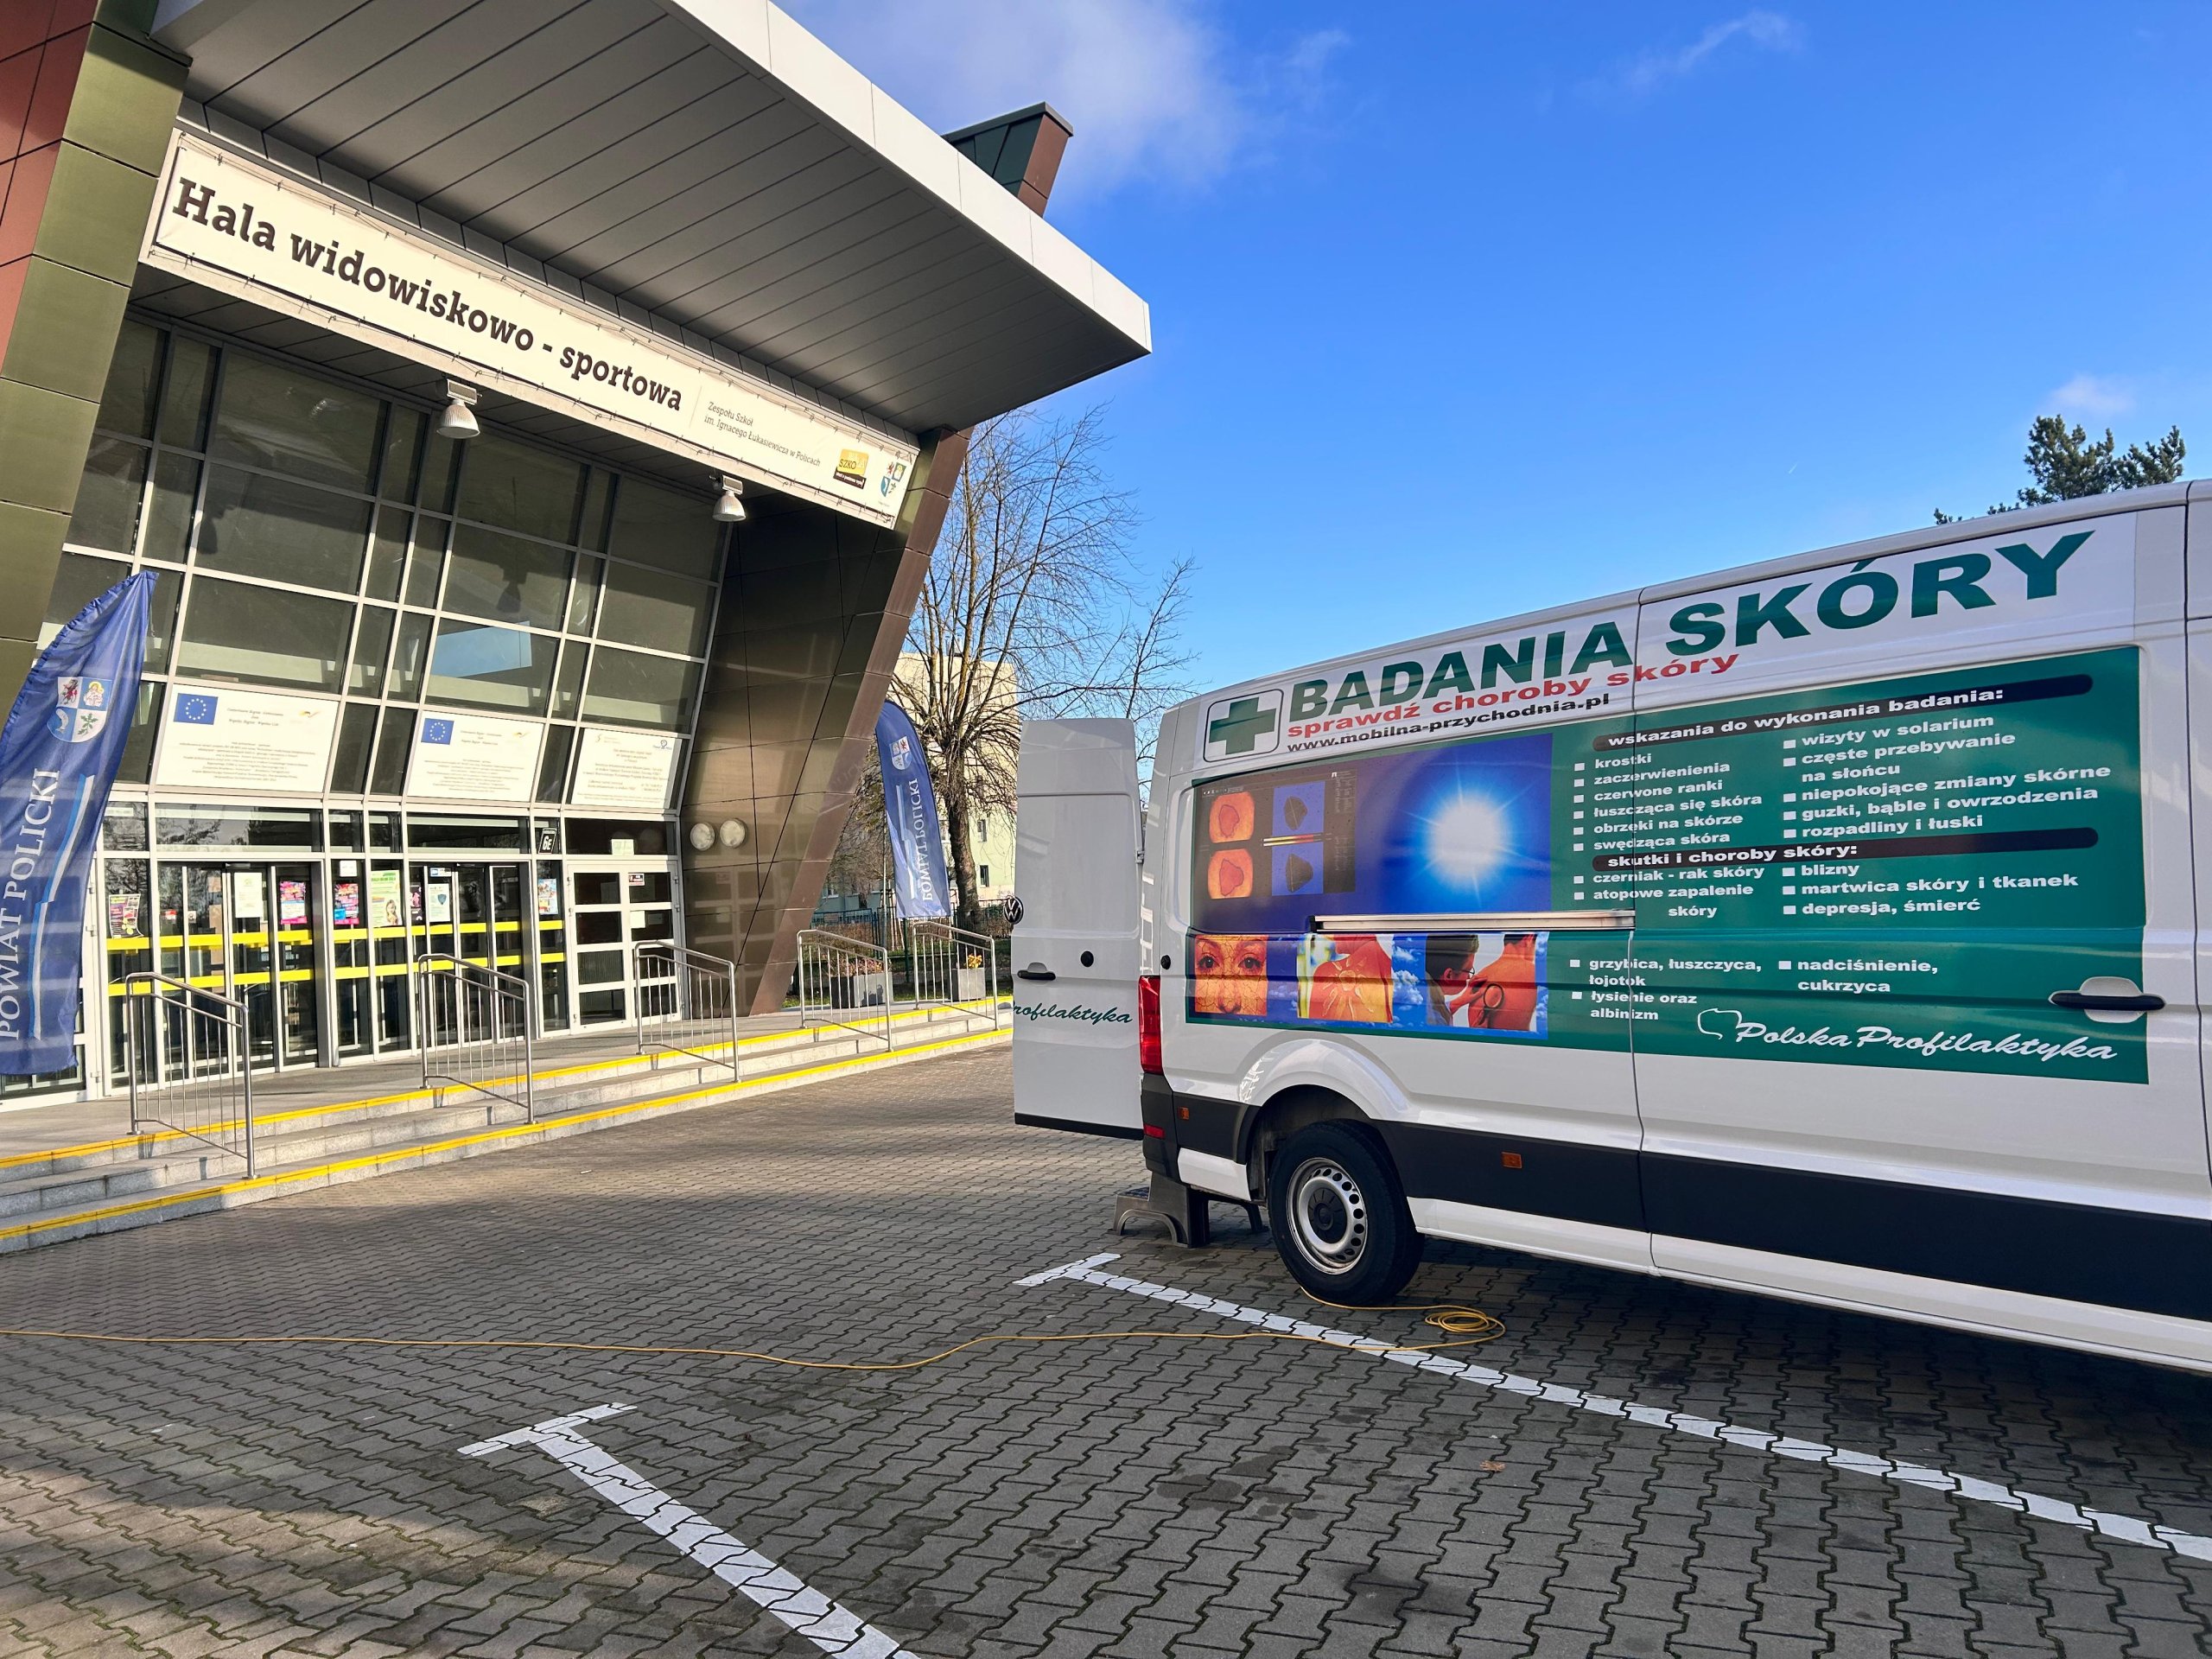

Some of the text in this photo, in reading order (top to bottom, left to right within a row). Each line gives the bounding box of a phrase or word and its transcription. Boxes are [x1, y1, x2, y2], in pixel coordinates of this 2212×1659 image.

[173, 176, 276, 251] Hala
[290, 232, 535, 352] widowiskowo
[559, 346, 683, 411] sportowa
[708, 401, 753, 427] Zespołu Szkół
[716, 419, 747, 438] Ignacego
[748, 430, 789, 454] Łukasiewicza
[796, 450, 821, 467] Policach
[1289, 530, 2095, 722] BADANIA SKÓRY
[1287, 654, 1739, 738] sprawdź choroby skóry
[1287, 693, 1609, 752] www.mobilna-przychodnia.pl
[1608, 690, 2003, 747] wskazania do wykonania badania:
[1802, 716, 1994, 747] wizyty w solarium
[1802, 734, 2016, 764] częste przebywanie
[1594, 753, 1652, 769] krostki
[1593, 762, 1731, 785] zaczerwienienia
[1802, 765, 1900, 782] na słońcu
[1802, 766, 2111, 800] niepokojące zmiany skórne
[1593, 779, 1723, 801] czerwone ranki
[1593, 794, 1763, 817] łuszcząca się skóra
[1802, 787, 2098, 821] guzki, bąble i owrzodzenia
[1593, 814, 1744, 835] obrzęki na skórze
[1802, 815, 1983, 837] rozpadliny i łuski
[1593, 832, 1731, 850] swędząca skóra
[1607, 844, 1857, 868] skutki i choroby skóry:
[1592, 869, 1664, 883] czerniak
[1679, 868, 1707, 880] rak
[1713, 866, 1764, 880] skóry
[1801, 864, 1859, 877] blizny
[1593, 884, 1754, 900] atopowe zapalenie
[1802, 874, 2079, 894] martwica skóry i tkanek
[0, 767, 60, 1040] POWIAT POLICKI
[1668, 905, 1718, 918] skóry
[1802, 898, 1981, 917] depresja, śmierć
[1589, 958, 1762, 972] grzybica, łuszczyca,
[1797, 957, 1938, 975] nadciśnienie,
[1588, 975, 1646, 987] łojotok
[1797, 978, 1891, 994] cukrzyca
[1591, 991, 1698, 1004] łysienie oraz
[1013, 1001, 1133, 1026] rofilaktyka
[1590, 1007, 1659, 1020] albinizm
[1735, 1022, 2118, 1062] Polska Profilaktyka
